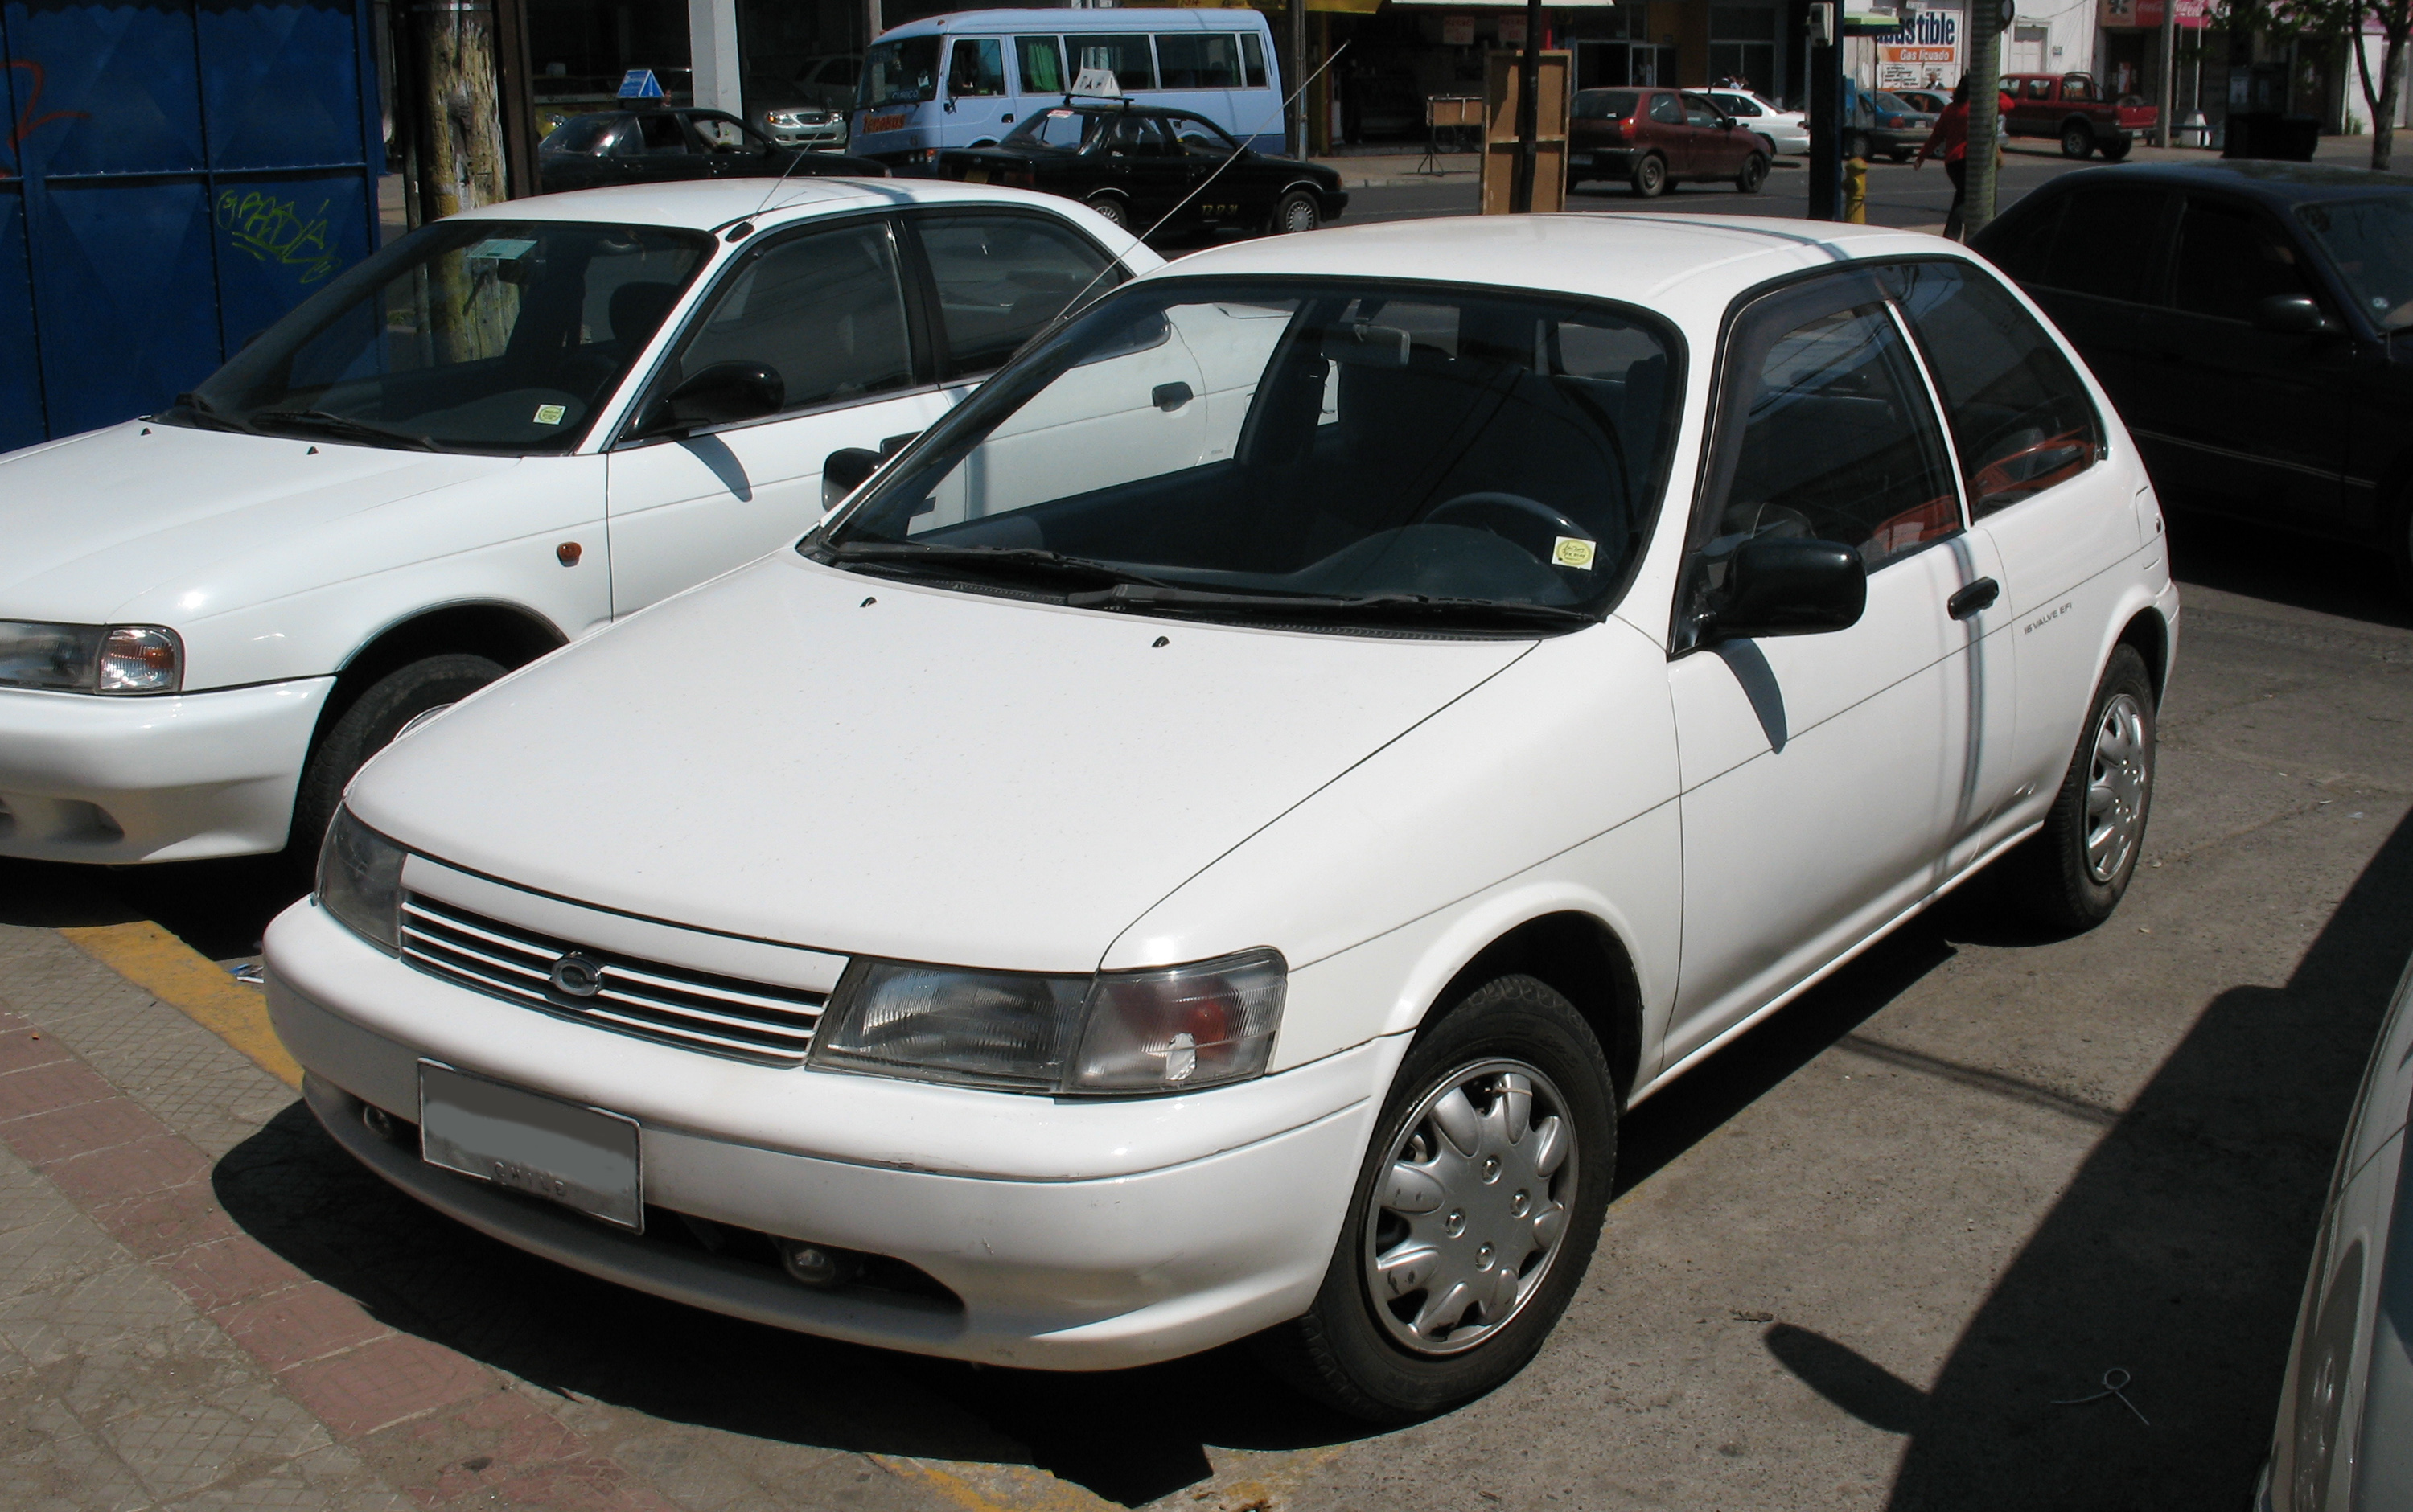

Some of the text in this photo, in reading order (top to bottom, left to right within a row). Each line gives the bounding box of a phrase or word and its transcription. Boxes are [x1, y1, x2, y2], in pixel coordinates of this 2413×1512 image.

[1900, 49, 1950, 61] Gas licuado
[2024, 601, 2073, 634] 16 VALVE EFI
[494, 1161, 566, 1197] CHILE
